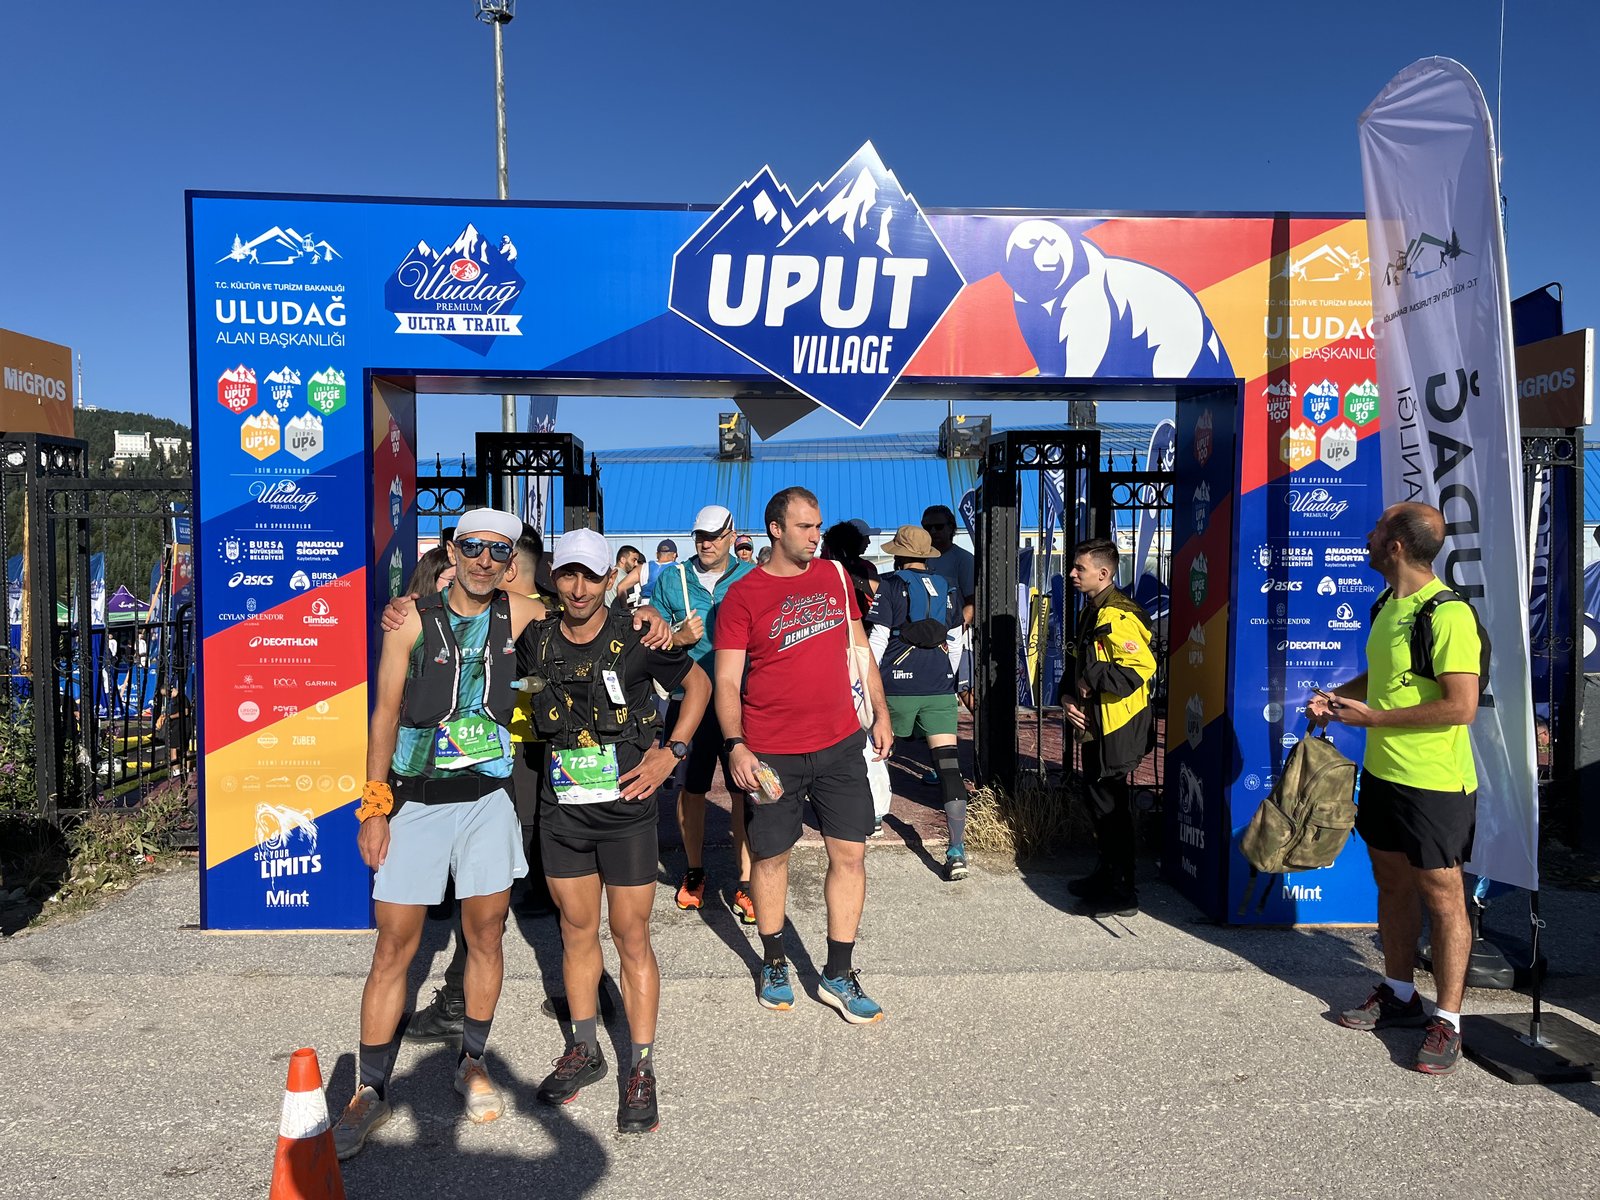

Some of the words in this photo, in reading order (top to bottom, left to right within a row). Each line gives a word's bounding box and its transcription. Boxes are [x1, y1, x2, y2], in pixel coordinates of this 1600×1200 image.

[215, 281, 229, 289] T.C.
[230, 281, 260, 290] KÜLTÜR
[274, 283, 303, 291] TURİZM
[304, 284, 345, 292] BAKANLIĞI
[398, 260, 520, 315] Uludağ
[708, 253, 928, 329] UPUT
[436, 302, 482, 311] PREMIUM
[1320, 299, 1347, 307] TURİZM
[215, 295, 346, 327] ULUDAĞ
[407, 316, 456, 331] ULTRA
[463, 317, 510, 332] TRAIL
[216, 331, 254, 345] ALAN
[259, 331, 345, 348] BAŞKANLIĞI
[793, 335, 893, 374] VILLAGE
[224, 387, 251, 400] UPUT
[272, 389, 293, 400] UPA
[313, 389, 340, 401] UPGE
[227, 397, 249, 408] 100
[276, 400, 289, 409] 66
[320, 399, 334, 409] 30
[1266, 400, 1292, 412] UPUT
[1311, 401, 1331, 412] UPA
[1349, 401, 1375, 412] UPGE
[1270, 410, 1288, 420] 100
[1314, 411, 1326, 420] 66
[1355, 411, 1368, 420] 30
[245, 435, 276, 449] UP16
[292, 436, 316, 449] UP6
[1327, 446, 1350, 459] UP6
[249, 541, 284, 549] BURSA
[296, 547, 339, 556] SİGORTA
[311, 572, 338, 580] BURSA
[311, 579, 351, 588] TELEFERİK
[1338, 585, 1375, 593] TELEFERİK
[303, 615, 338, 625] Climbolic
[1327, 620, 1361, 628] Climbolic
[263, 638, 318, 646] DECATHLON
[784, 627, 810, 646] DENIM
[1289, 641, 1341, 650] DECATHLON
[458, 723, 485, 740] 314
[570, 755, 598, 770] 725
[1179, 823, 1205, 849] LIMITS
[269, 849, 289, 859] YOUR
[260, 855, 322, 879] LIMITS
[266, 889, 309, 905] Mint
[1282, 885, 1322, 900] Mint
